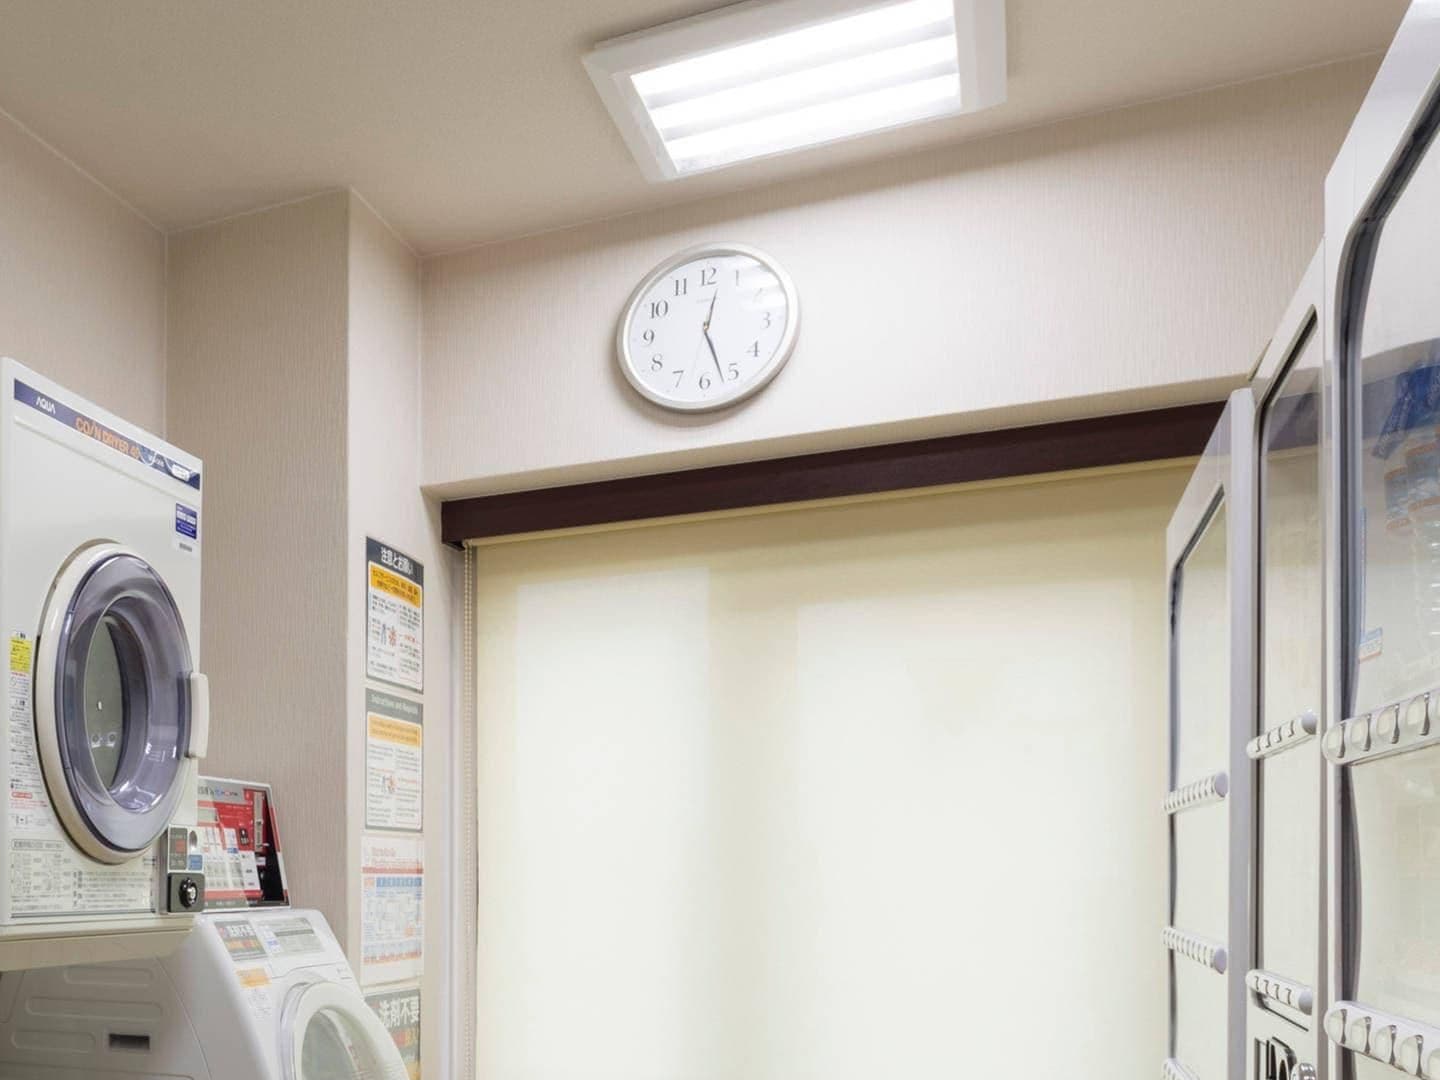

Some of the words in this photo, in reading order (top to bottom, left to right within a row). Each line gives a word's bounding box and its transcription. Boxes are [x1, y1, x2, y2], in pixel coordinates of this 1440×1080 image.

[700, 267, 717, 286] 12
[735, 270, 740, 286] 1
[674, 278, 688, 296] 11
[650, 300, 669, 319] 10
[762, 312, 771, 329] 3
[643, 329, 655, 345] 9
[746, 340, 760, 357] 4
[651, 353, 663, 371] 8
[673, 370, 684, 388] 7
[728, 363, 739, 380] 5
[699, 375, 711, 390] 6
[36, 397, 56, 414] AQUA
[102, 432, 128, 455] DRYER
